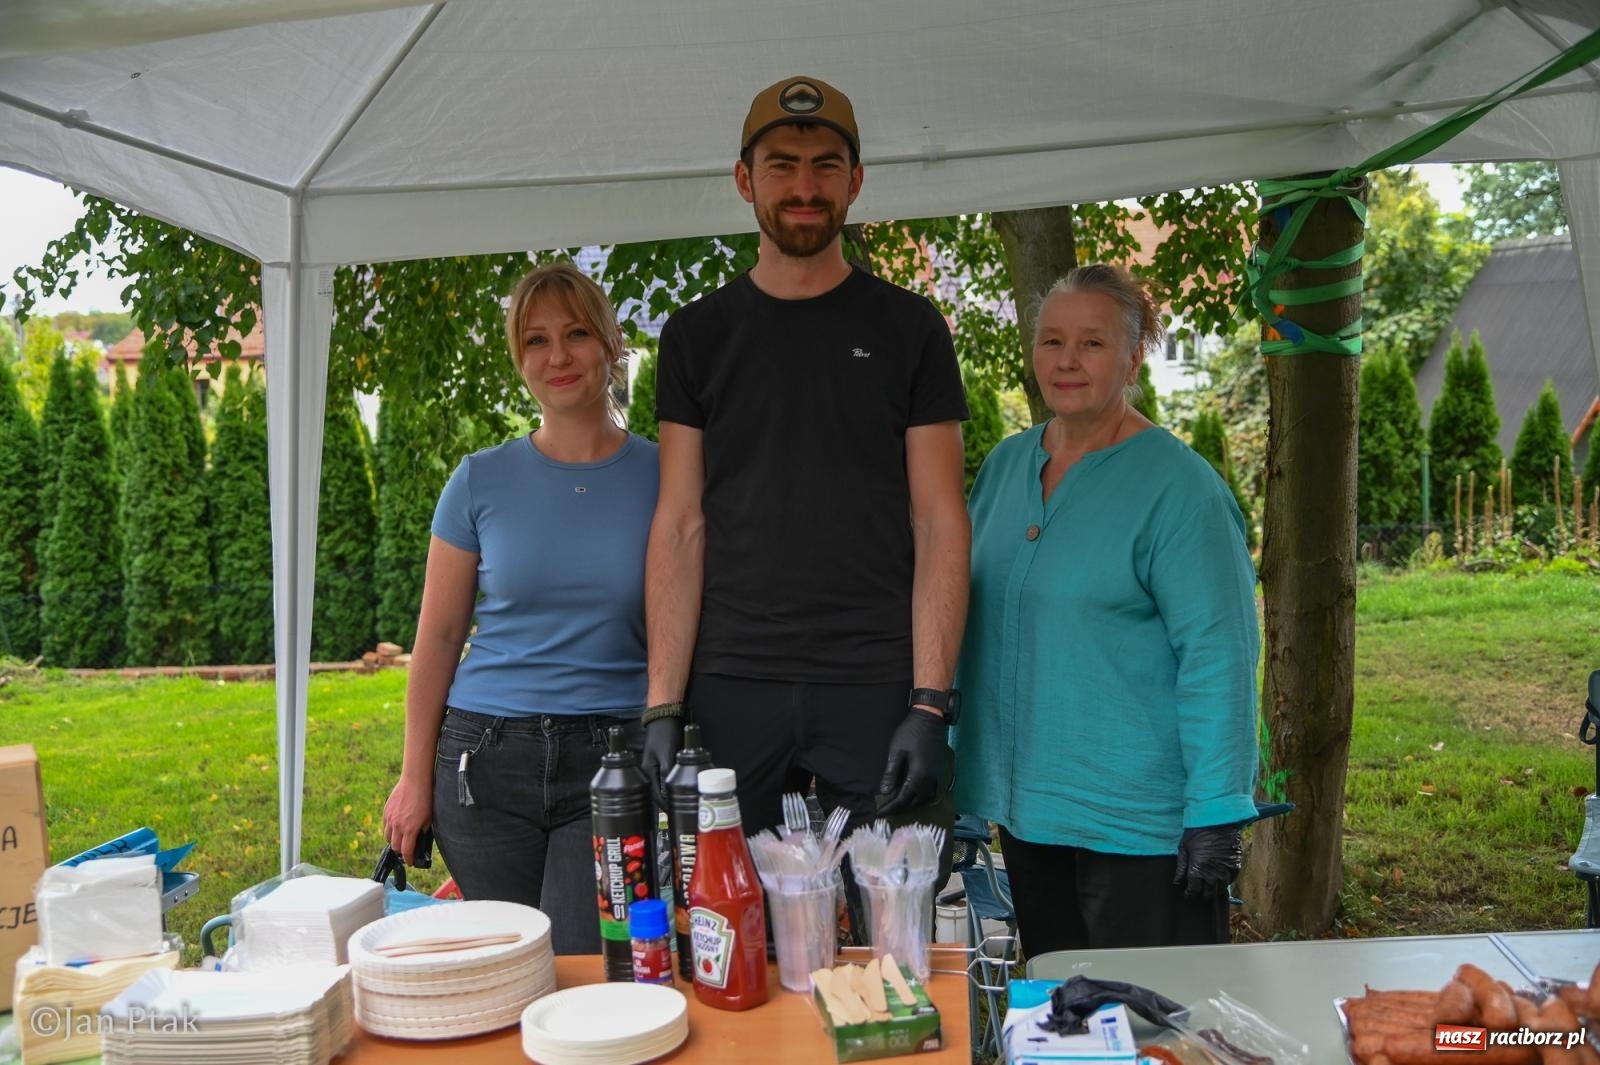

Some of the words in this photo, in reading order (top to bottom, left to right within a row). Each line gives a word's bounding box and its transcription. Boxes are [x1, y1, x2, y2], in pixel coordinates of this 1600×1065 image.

[2, 826, 17, 851] A
[607, 837, 622, 862] GRILL
[609, 864, 625, 904] KETCHUP
